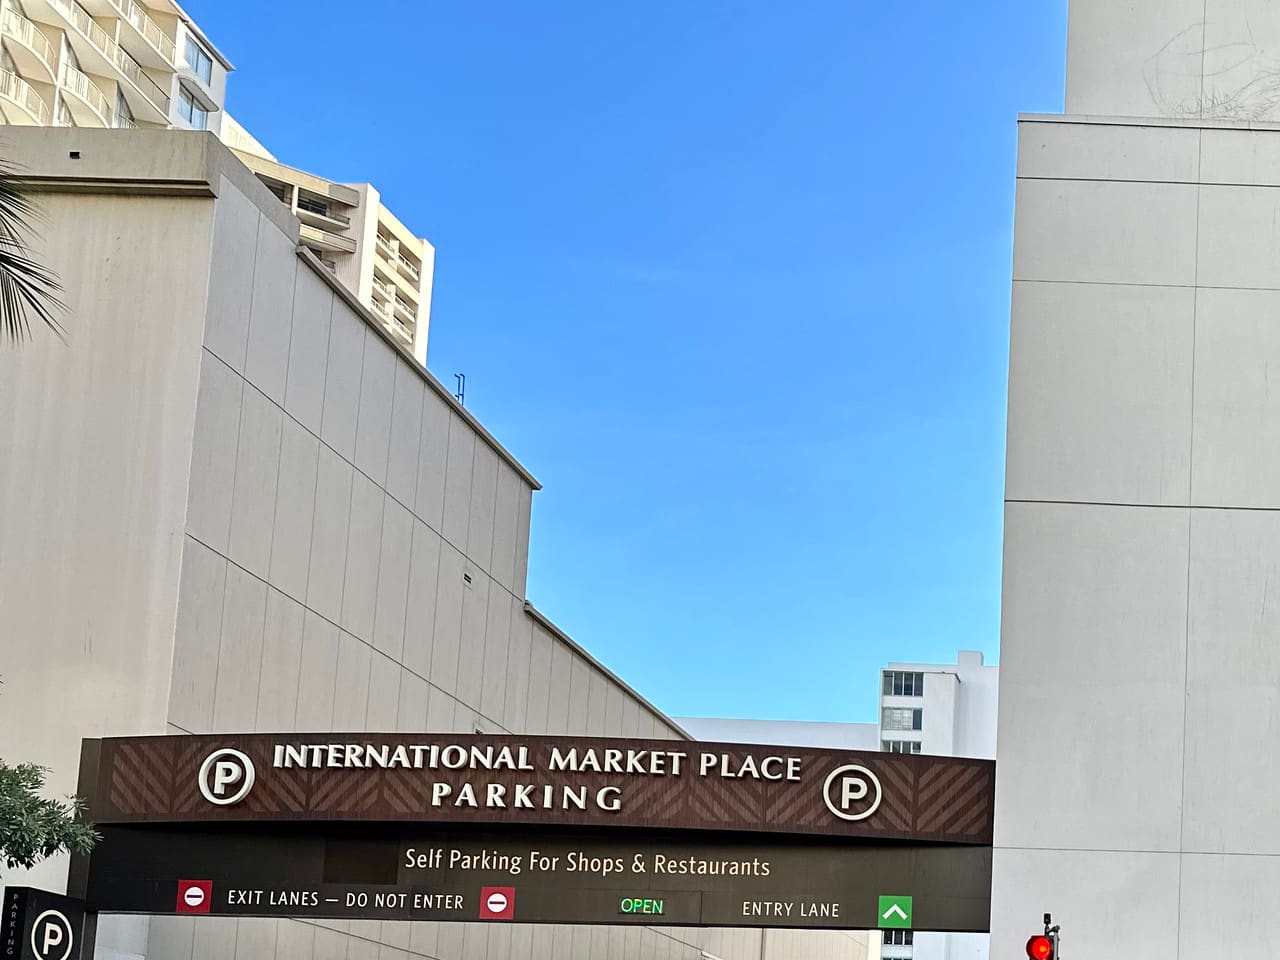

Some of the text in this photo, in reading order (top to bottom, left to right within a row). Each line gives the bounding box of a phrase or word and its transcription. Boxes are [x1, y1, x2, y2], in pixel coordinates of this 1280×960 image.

[213, 761, 242, 795] P
[272, 744, 802, 781] INTERNATIONAL MARKET PLACE
[431, 782, 622, 811] PARKING
[841, 776, 868, 809] P
[405, 848, 770, 877] Self Parking For Shops & Restaurants
[228, 889, 264, 905] EXIT
[269, 890, 319, 906] LANES
[346, 892, 368, 908] DO
[374, 893, 408, 908] NOT
[413, 894, 464, 910] ENTER
[621, 898, 664, 914] OPEN
[742, 901, 840, 918] ENTRY LANE
[6, 893, 19, 956] PARKING
[42, 922, 63, 955] P
